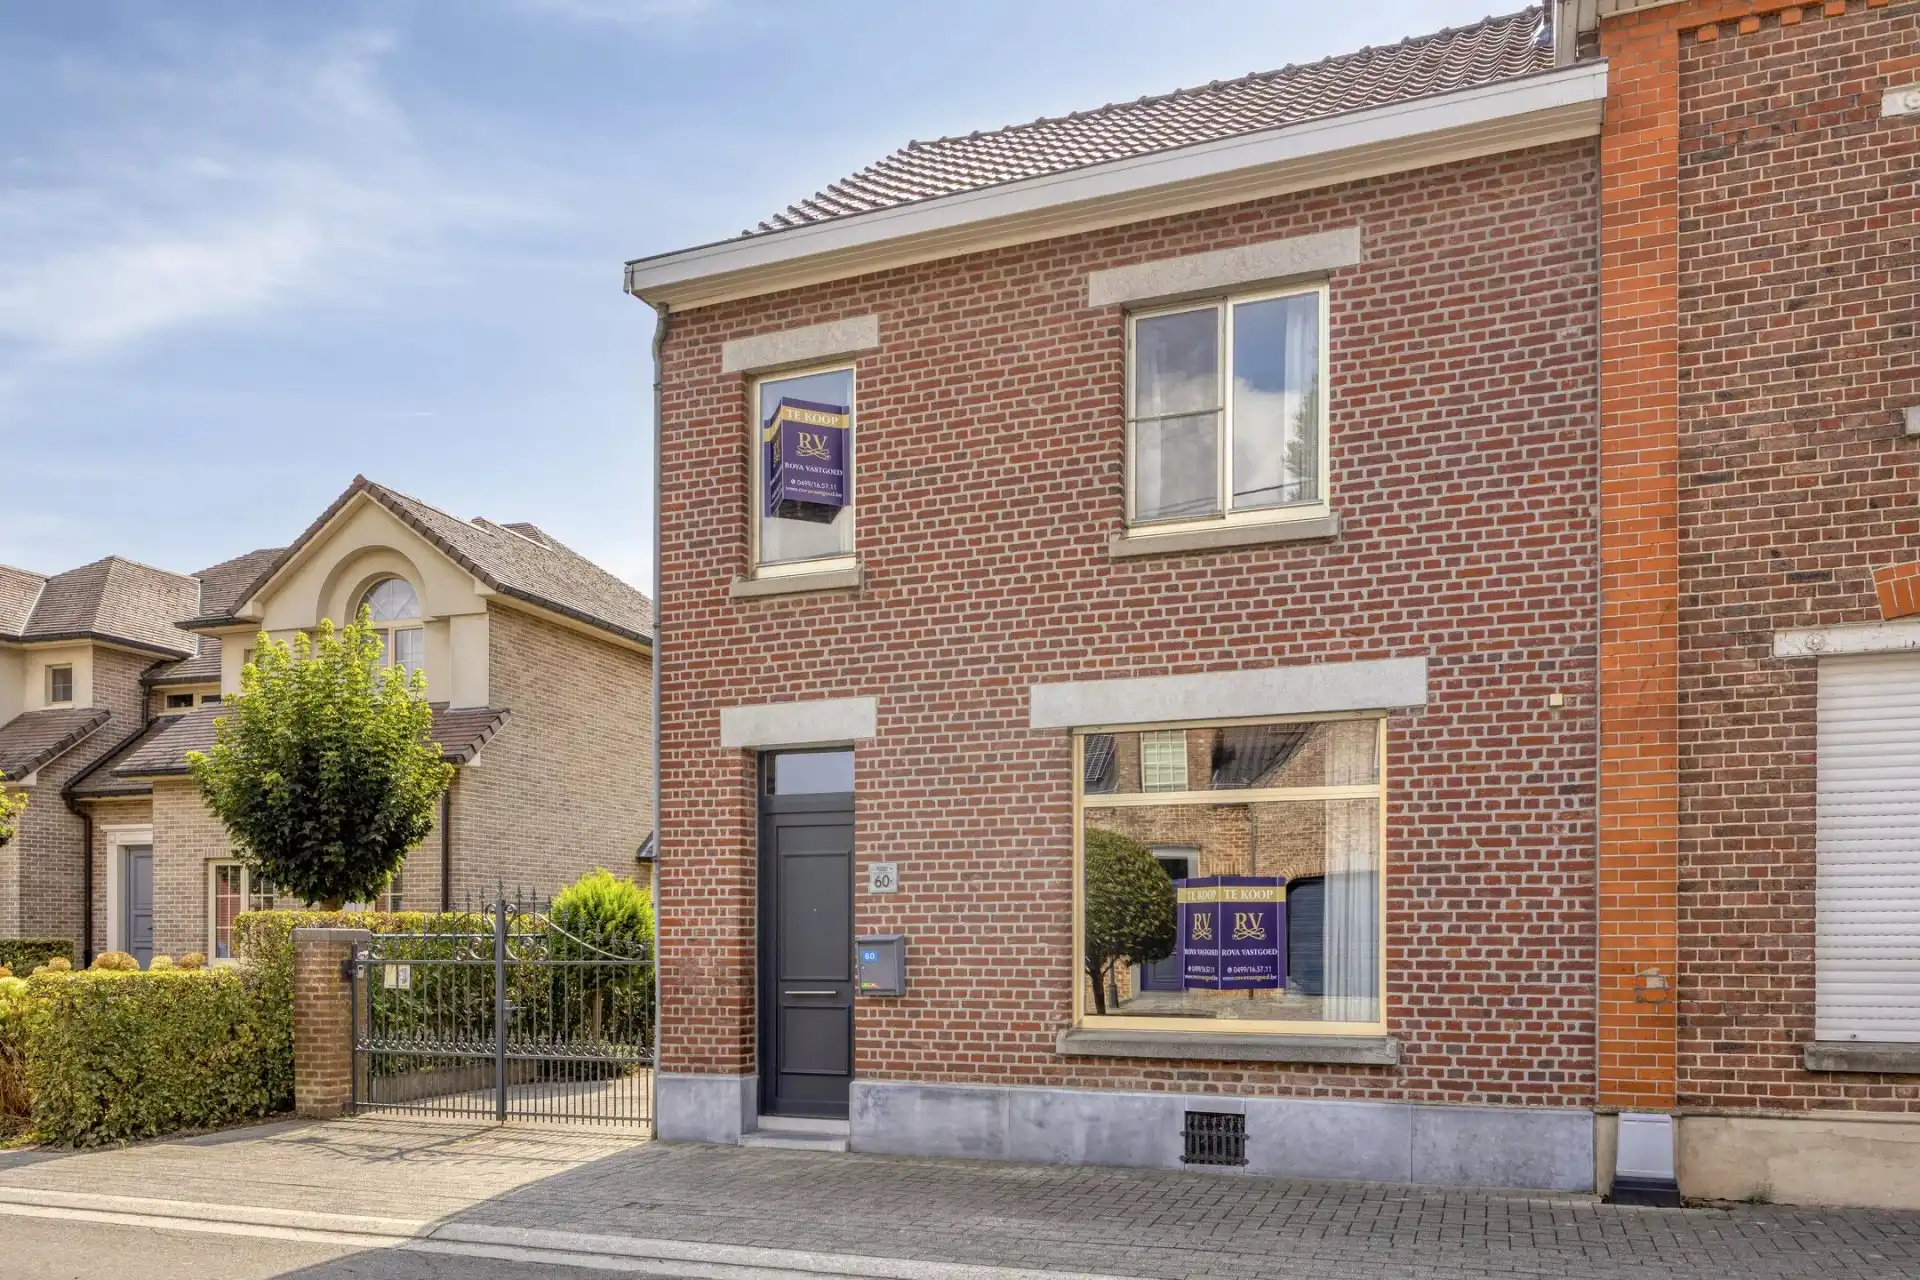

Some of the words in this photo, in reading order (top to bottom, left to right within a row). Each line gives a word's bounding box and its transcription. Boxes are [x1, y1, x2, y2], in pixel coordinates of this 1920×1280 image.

[786, 409, 800, 420] TE
[804, 412, 839, 425] KOOP
[798, 431, 828, 450] RV
[784, 462, 804, 471] ROVA
[806, 464, 843, 476] VASTGOED
[875, 874, 889, 888] 60
[1187, 892, 1197, 900] TE
[1199, 890, 1217, 900] KOOP
[1223, 889, 1237, 899] TE
[1241, 889, 1274, 900] KOOP
[1193, 912, 1211, 930] RV
[1234, 912, 1264, 930] RV
